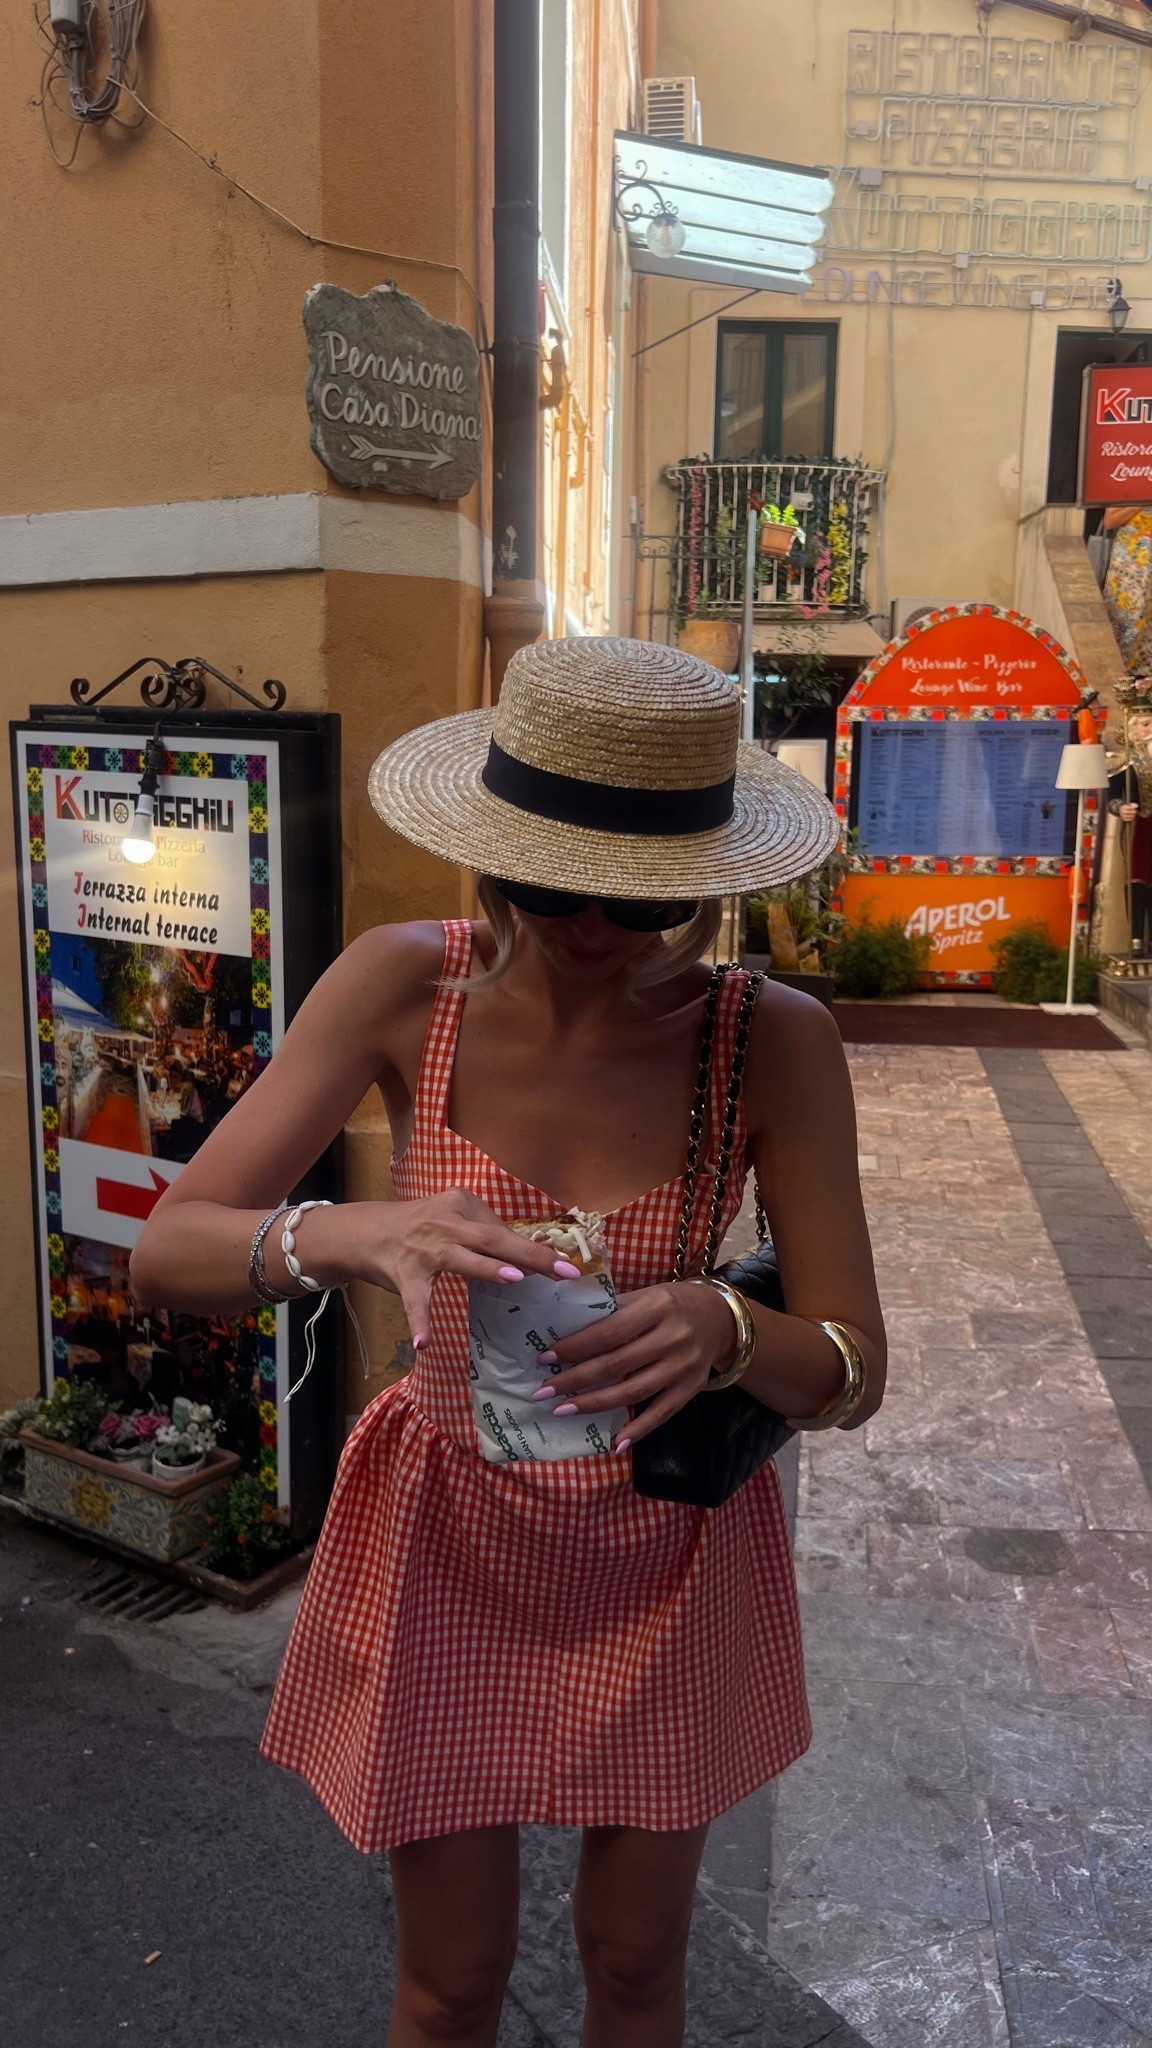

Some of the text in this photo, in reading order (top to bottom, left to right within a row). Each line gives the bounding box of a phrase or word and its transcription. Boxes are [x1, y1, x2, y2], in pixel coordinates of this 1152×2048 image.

[846, 29, 1141, 102] RISTORANTE
[879, 98, 1100, 172] PIZZERIA
[321, 330, 467, 394] Pensione
[320, 382, 480, 441] Casa Diana
[901, 656, 968, 673] Ristorante
[983, 654, 1037, 676] Pizzeria
[910, 678, 954, 697] Lounge
[156, 836, 206, 854] Pizzeria
[73, 871, 220, 911] Terrazza interna
[156, 914, 218, 944] terrace
[903, 896, 1011, 939] APEROL
[928, 929, 983, 954] Spritz
[503, 1407, 527, 1441] FLAVORS
